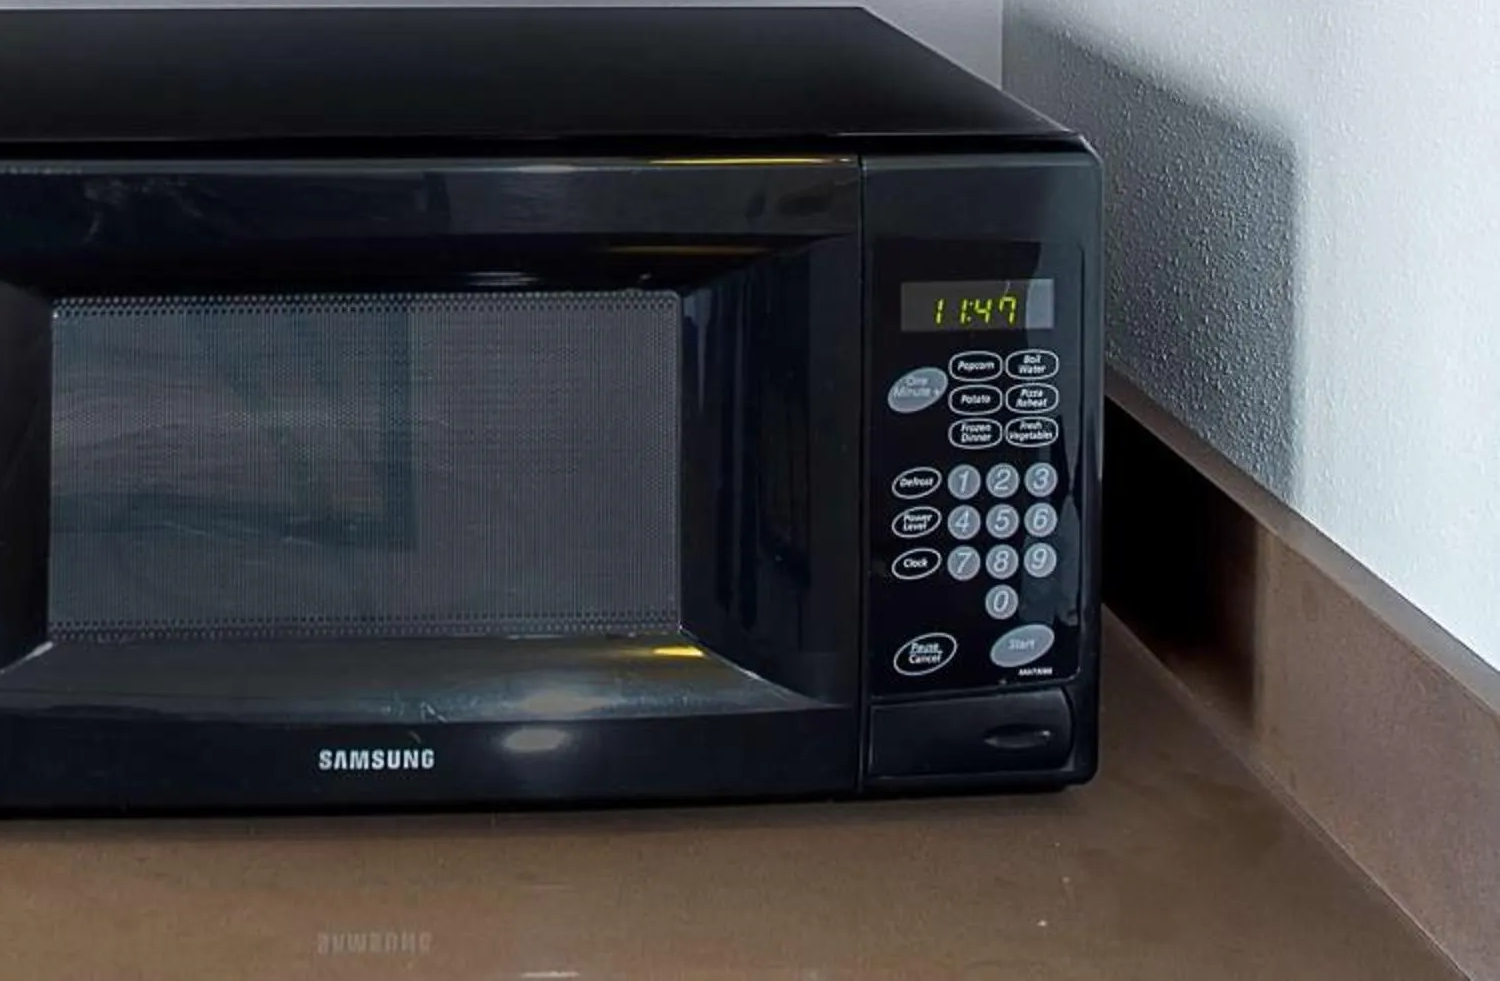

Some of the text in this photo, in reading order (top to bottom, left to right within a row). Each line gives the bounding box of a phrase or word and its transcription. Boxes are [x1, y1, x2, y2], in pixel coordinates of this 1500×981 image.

[935, 295, 1018, 325] 11:47
[1023, 355, 1042, 364] Boil
[957, 360, 996, 373] Popcorn
[1019, 364, 1047, 374] Water
[1019, 388, 1043, 398] Pizza
[960, 394, 992, 405] Potato
[1015, 398, 1048, 408] Reheat
[960, 422, 993, 432] Frozen
[1019, 421, 1042, 430] Fresh
[960, 432, 992, 444] Dinner
[899, 477, 934, 487] Defrost
[958, 469, 970, 492] 1
[994, 469, 1012, 491] 2
[1032, 468, 1050, 491] 3
[903, 514, 932, 523] Power
[954, 510, 970, 532] 4
[994, 509, 1011, 531] 5
[1032, 508, 1049, 530] 6
[903, 522, 928, 532] Level
[903, 558, 928, 568] Clock
[956, 551, 972, 574] 7
[994, 549, 1011, 573] 8
[1031, 548, 1048, 570] 9
[993, 590, 1011, 613] 0
[1007, 638, 1036, 650] Start
[908, 654, 942, 665] Cancel
[319, 748, 436, 771] SAMSUNG
